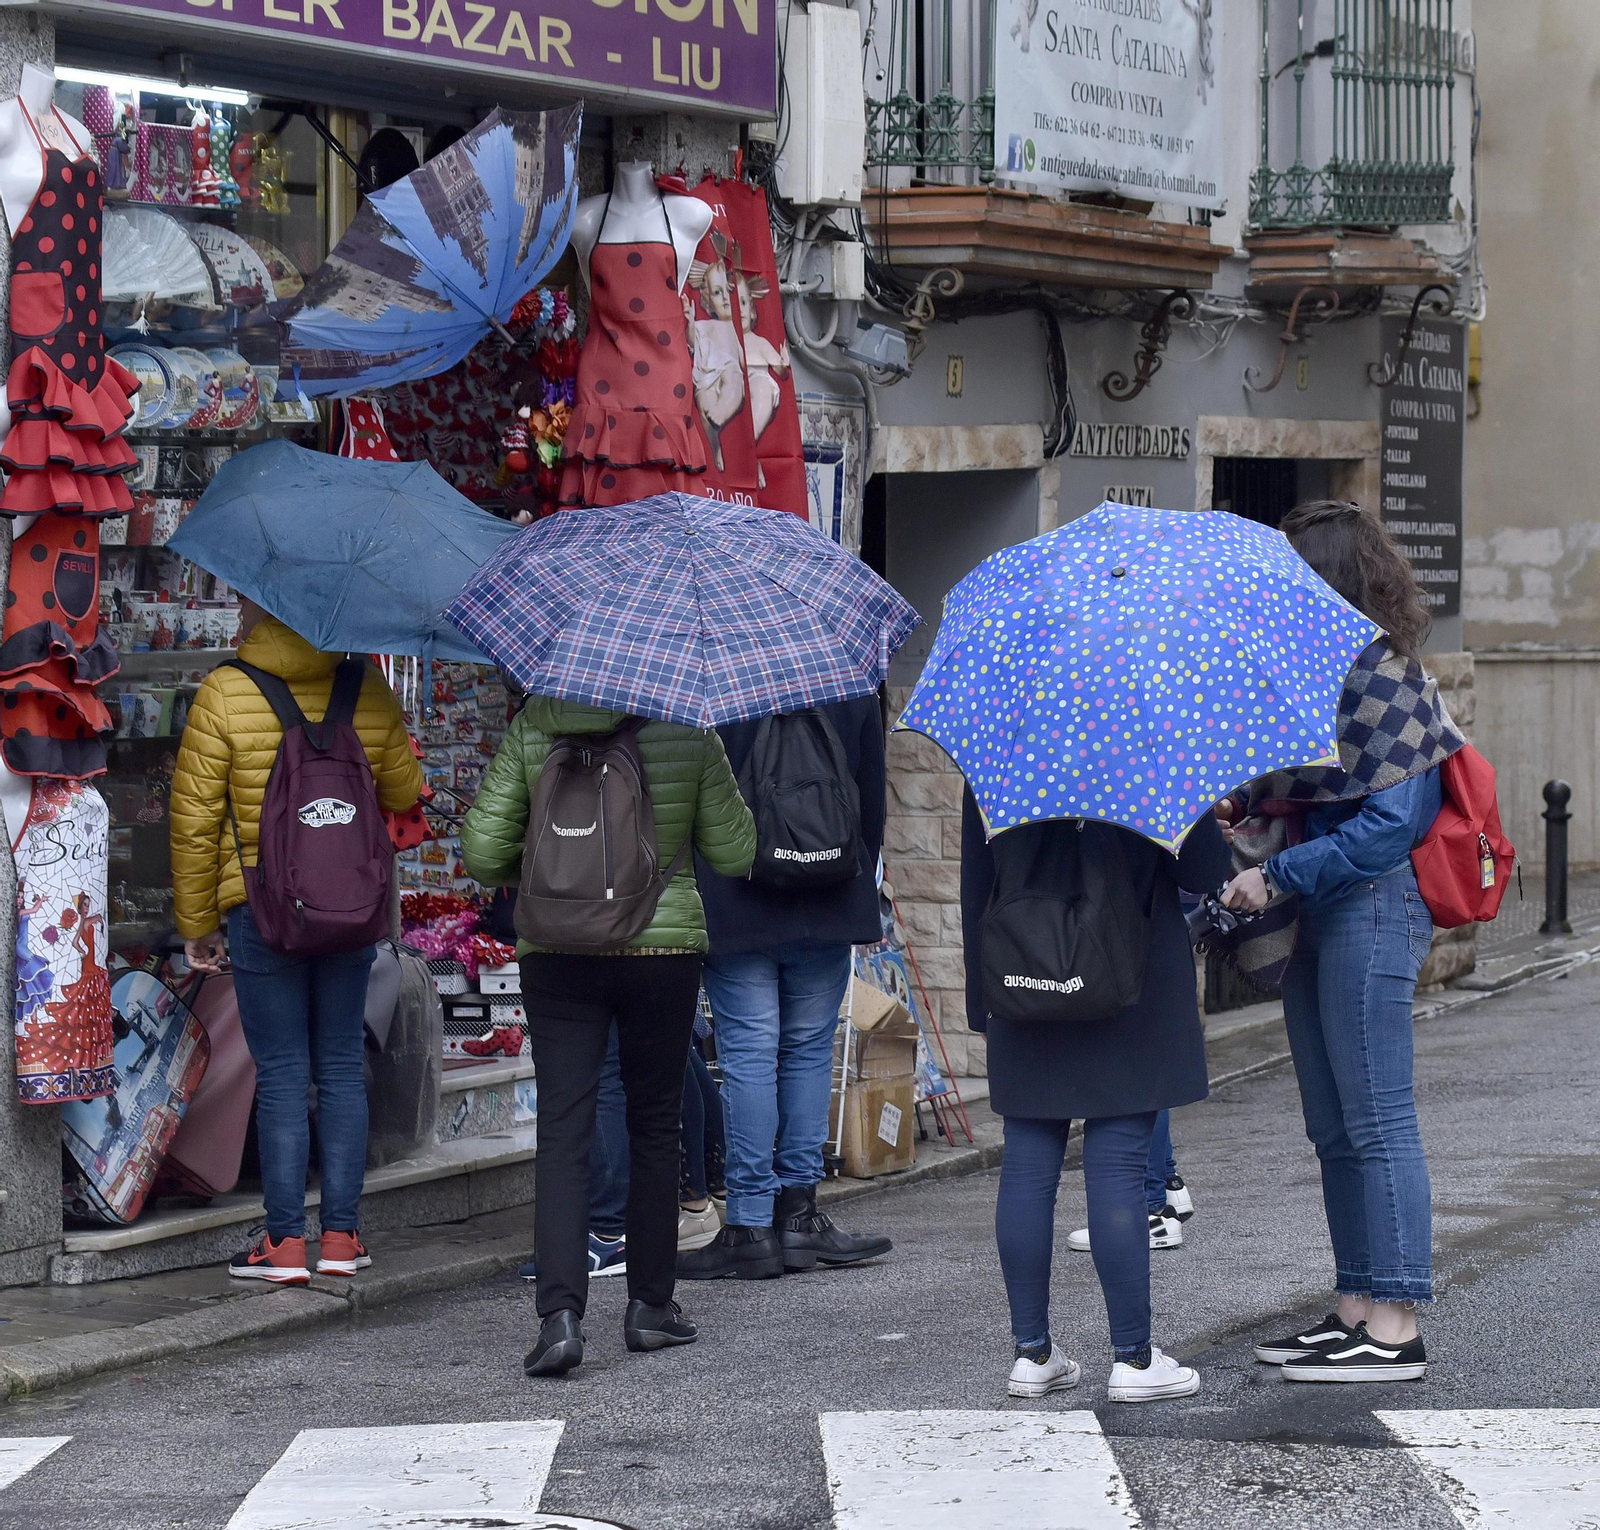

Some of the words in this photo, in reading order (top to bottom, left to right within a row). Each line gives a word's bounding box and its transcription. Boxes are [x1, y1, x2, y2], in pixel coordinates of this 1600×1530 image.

[383, 0, 575, 67] BAZAR
[652, 36, 721, 91] LIU
[1128, 92, 1164, 118] VENTA
[314, 801, 334, 812] VANS
[1003, 975, 1085, 994] ausoniaviaggi
